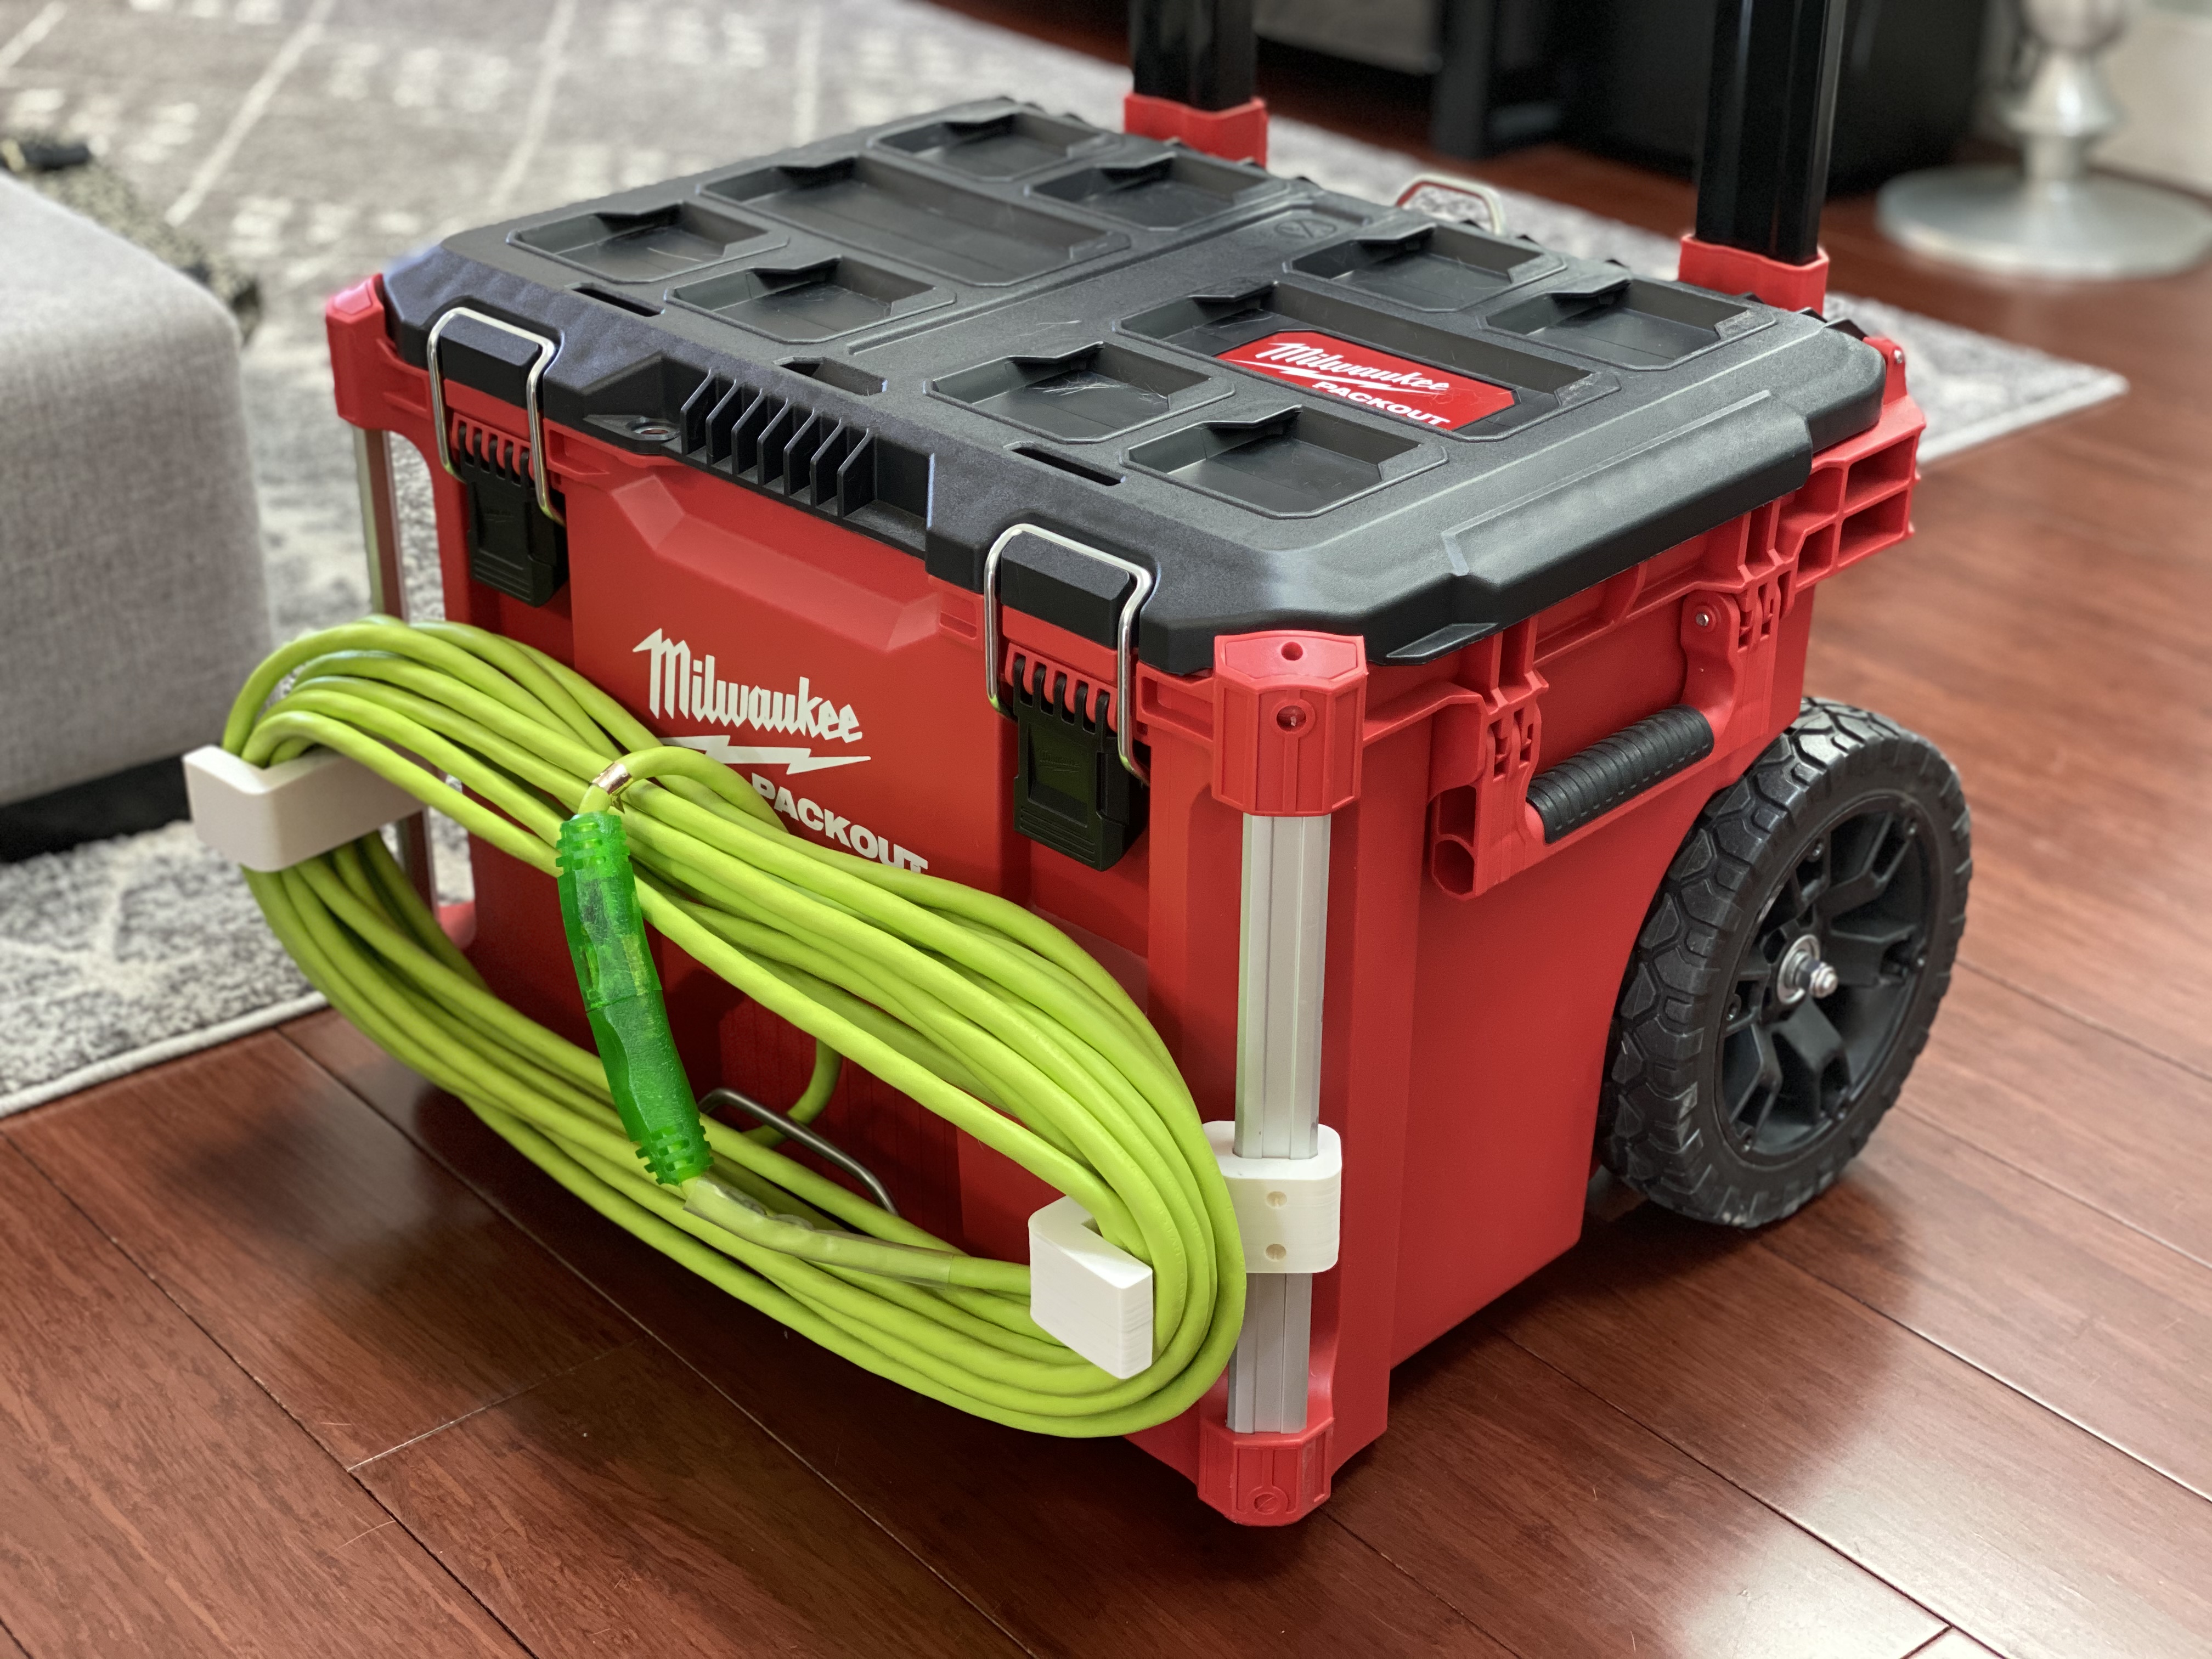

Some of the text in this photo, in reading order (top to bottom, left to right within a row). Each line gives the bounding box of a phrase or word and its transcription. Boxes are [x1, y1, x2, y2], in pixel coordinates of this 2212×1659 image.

[1255, 342, 1450, 391] Milwaukee
[1312, 381, 1451, 426] PACKOUT
[633, 628, 863, 743] Milwaukee
[751, 772, 928, 874] PACKOUT
